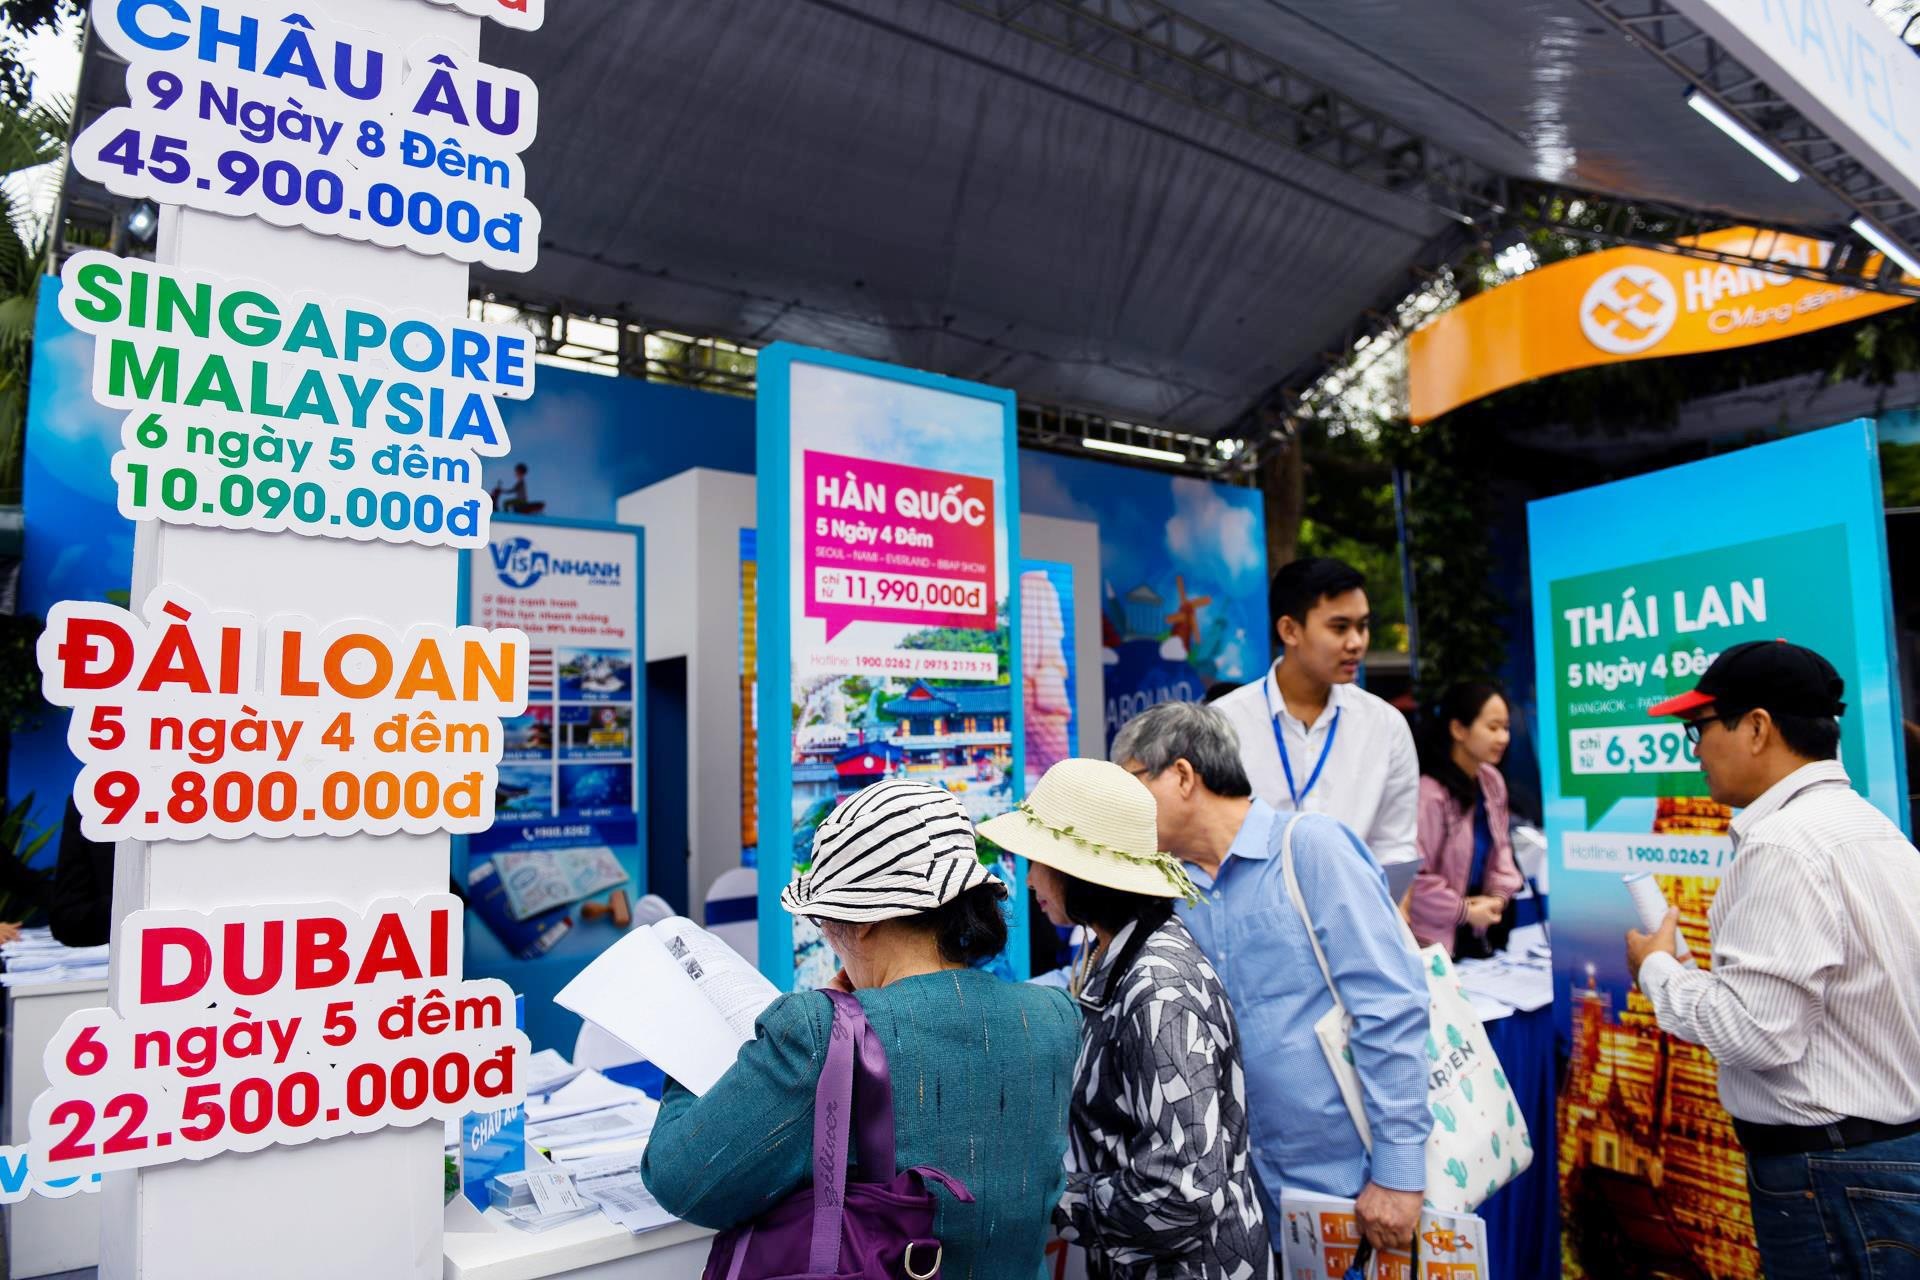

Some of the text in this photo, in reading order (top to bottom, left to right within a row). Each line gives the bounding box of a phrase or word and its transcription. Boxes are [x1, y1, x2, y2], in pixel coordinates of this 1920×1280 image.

[116, 0, 521, 137] CHÂU ÂU
[147, 70, 510, 189] 9 Ngày 8 Đêm
[98, 129, 523, 253] 45.900.000đ
[74, 263, 525, 388] SINGAPORE
[108, 338, 499, 445] MALAYSIA
[136, 413, 470, 484] 6 ngày 5 đêm
[127, 463, 480, 538] 10.090.000đ
[816, 470, 986, 527] HÀN QUỐC
[816, 518, 934, 549] 5 Ngày 4 Đêm
[845, 576, 980, 609] 11,990,000đ
[1564, 577, 1767, 648] THÁI LAN
[58, 600, 516, 703] ĐÀI LOAN
[1568, 663, 1583, 688] 5
[1586, 656, 1647, 691] Ngày
[1651, 653, 1668, 679] 4
[88, 704, 490, 764] 5 ngày 4 đêm
[94, 770, 484, 825] 9.800.000đ
[140, 909, 449, 1005] DUBAI
[65, 989, 501, 1078] 6 ngày 5 đêm
[48, 1045, 516, 1162] 22.500.000đ
